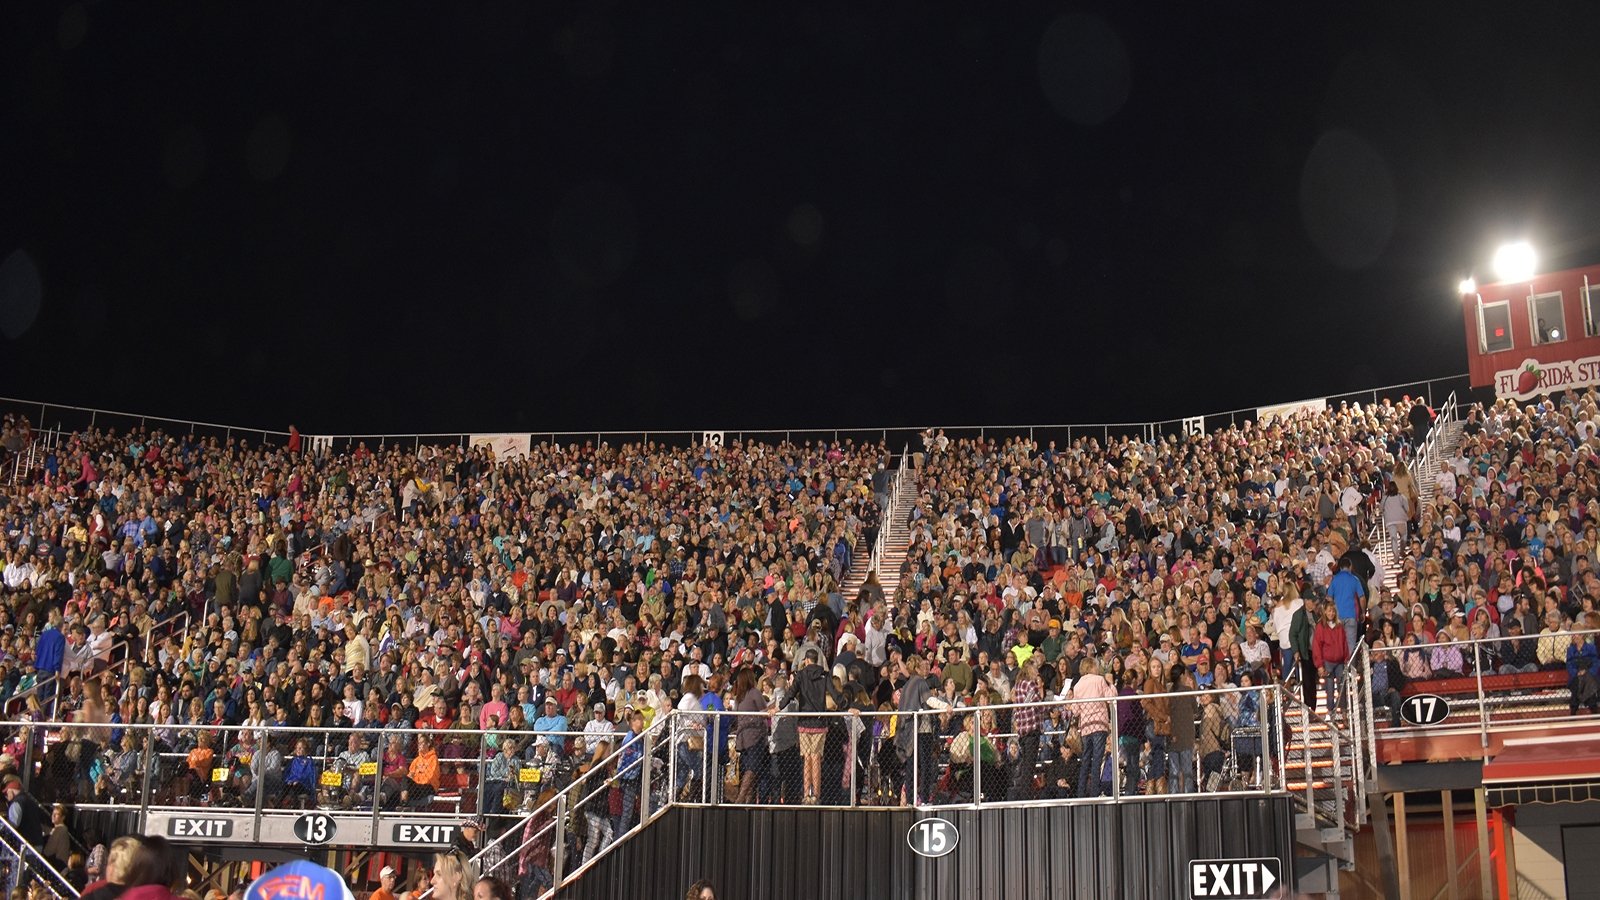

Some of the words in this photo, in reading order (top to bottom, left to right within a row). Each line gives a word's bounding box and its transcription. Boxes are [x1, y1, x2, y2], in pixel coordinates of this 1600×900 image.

[1578, 361, 1600, 381] ST
[1411, 698, 1437, 722] 17
[174, 819, 226, 836] EXIT
[305, 816, 327, 841] 13
[400, 825, 454, 843] EXIT
[920, 823, 946, 852] 15
[1193, 863, 1257, 896] EXIT
